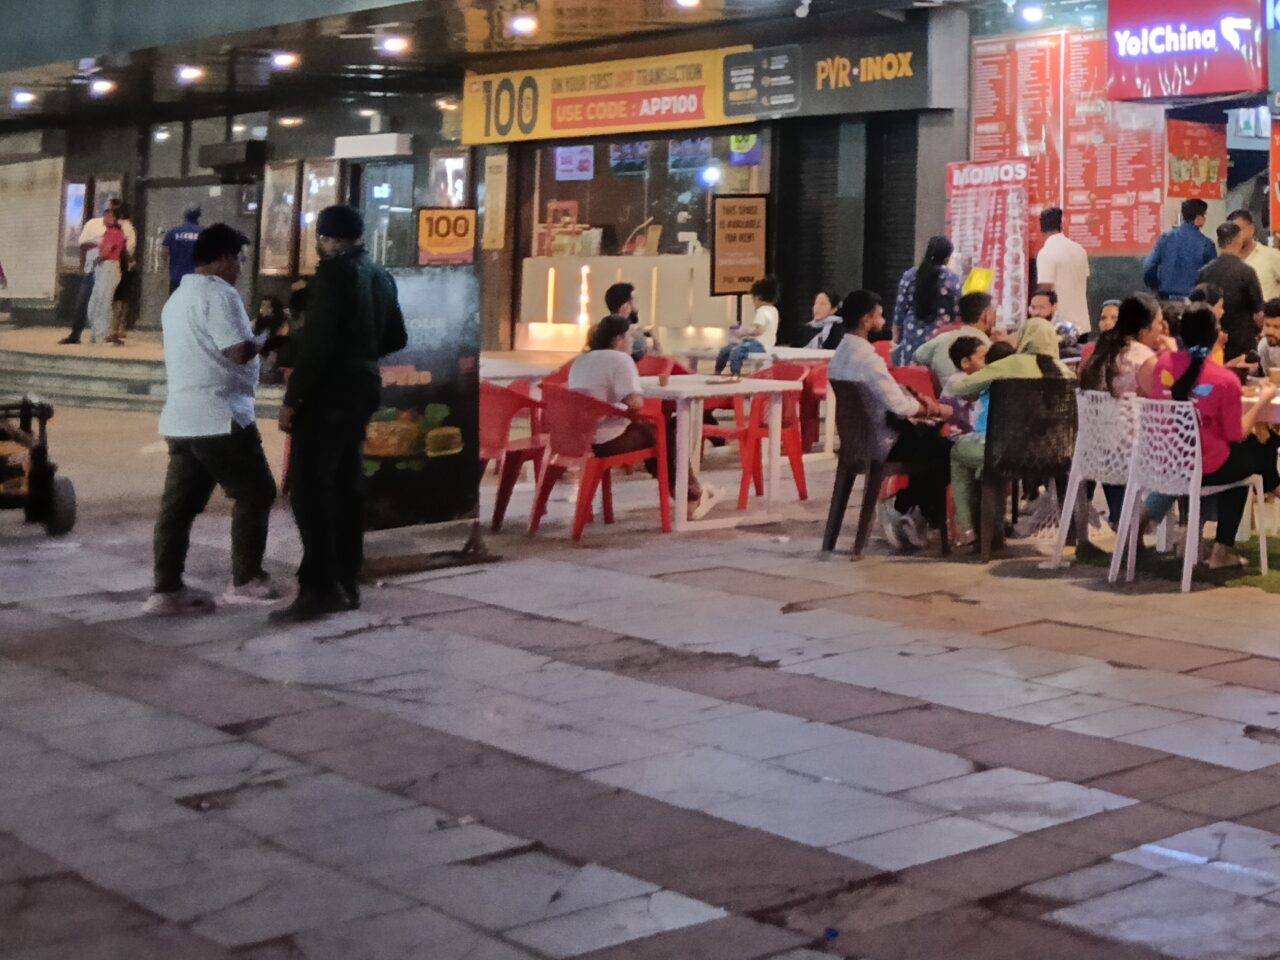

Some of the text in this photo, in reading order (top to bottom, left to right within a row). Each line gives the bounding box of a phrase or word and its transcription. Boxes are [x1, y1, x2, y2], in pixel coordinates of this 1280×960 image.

[1113, 24, 1217, 59] Yo!China
[589, 72, 613, 90] FIRST
[815, 56, 851, 91] PVR
[858, 52, 914, 83] INOX
[481, 75, 539, 138] 100
[556, 103, 583, 122] USE
[586, 101, 629, 120] CODE
[639, 94, 698, 117] APP100
[952, 163, 1028, 186] MOMOS
[425, 216, 470, 237] 100
